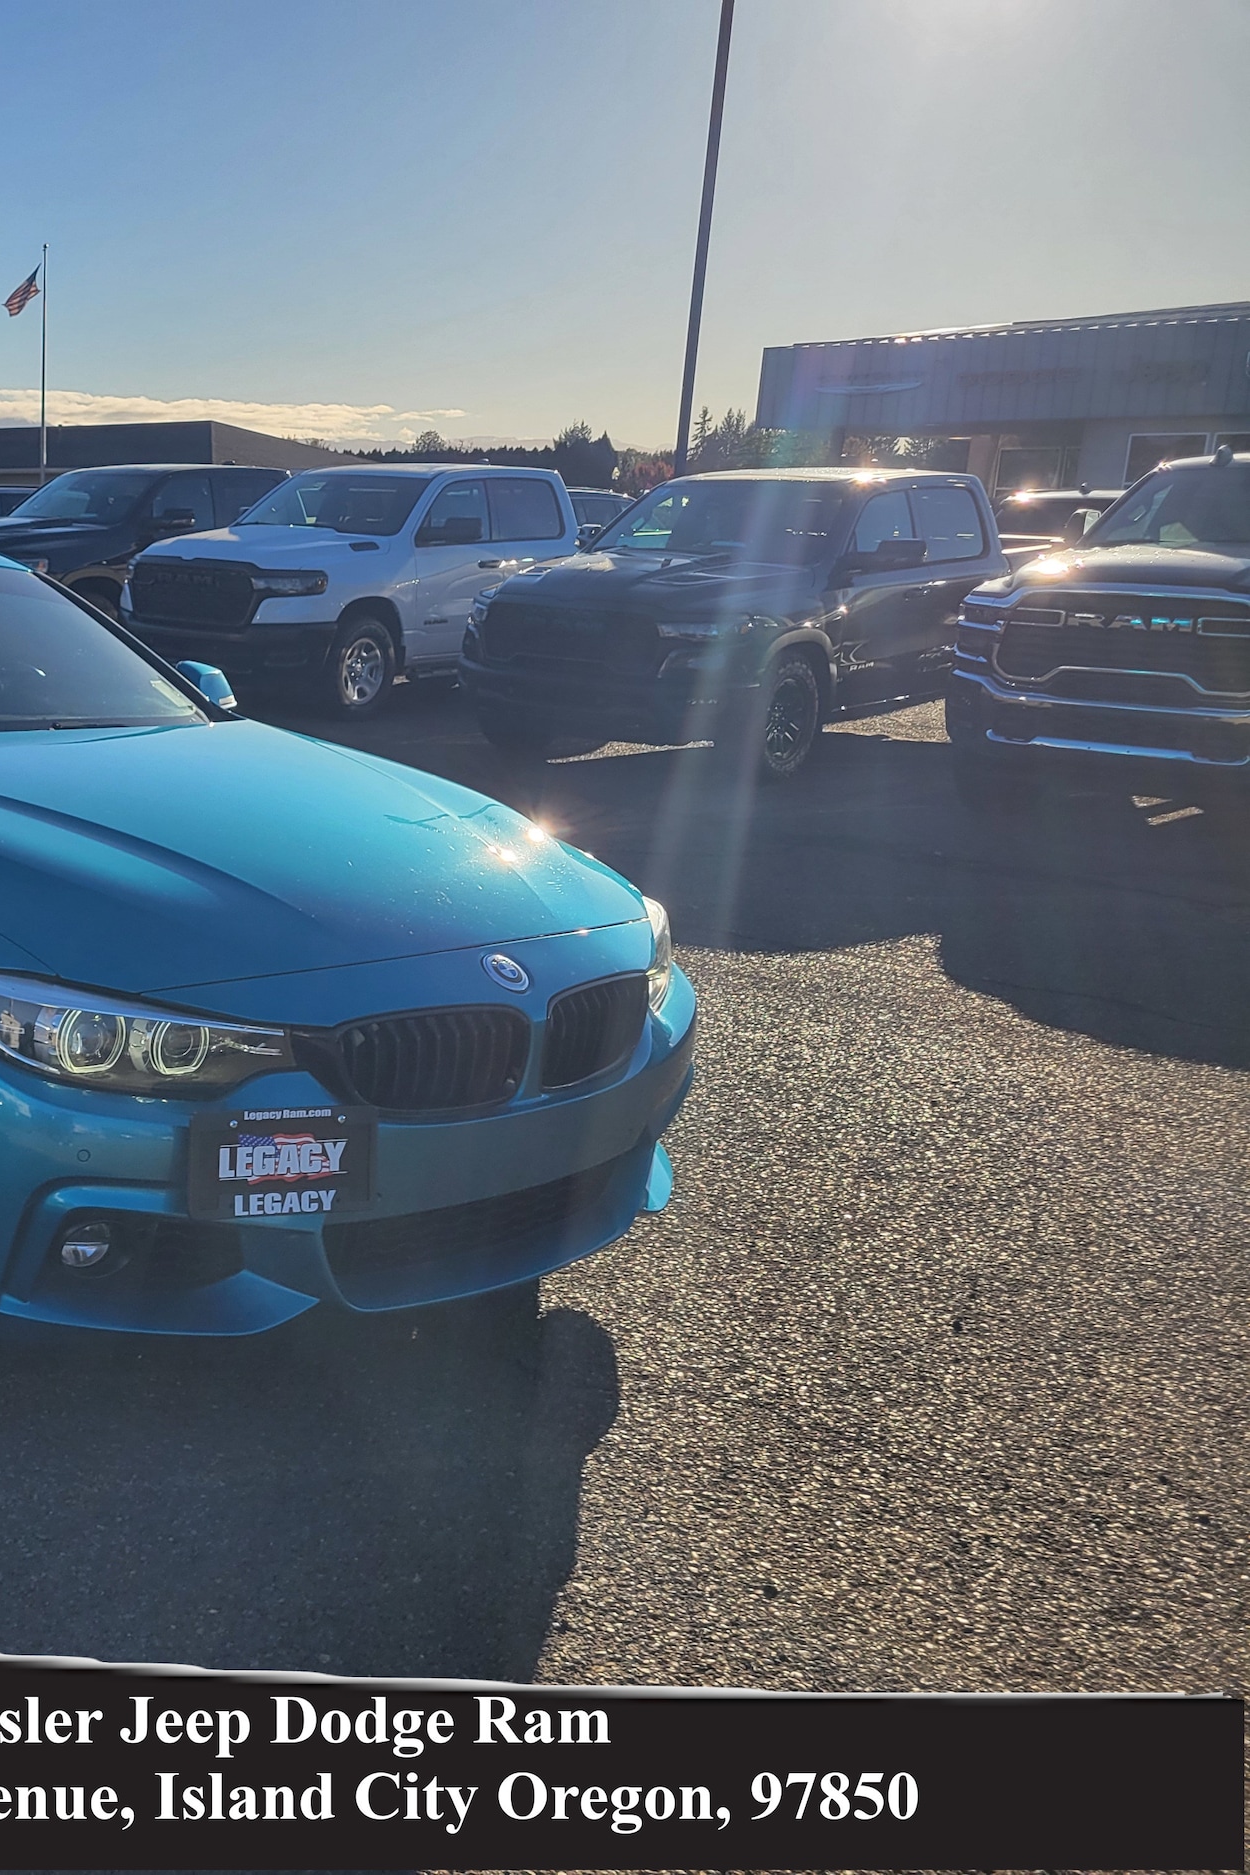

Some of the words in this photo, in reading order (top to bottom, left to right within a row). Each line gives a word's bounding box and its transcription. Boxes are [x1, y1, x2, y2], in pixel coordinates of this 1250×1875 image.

[1067, 612, 1194, 632] RAM
[218, 1141, 348, 1179] LEGACY
[234, 1189, 337, 1217] LEGACY
